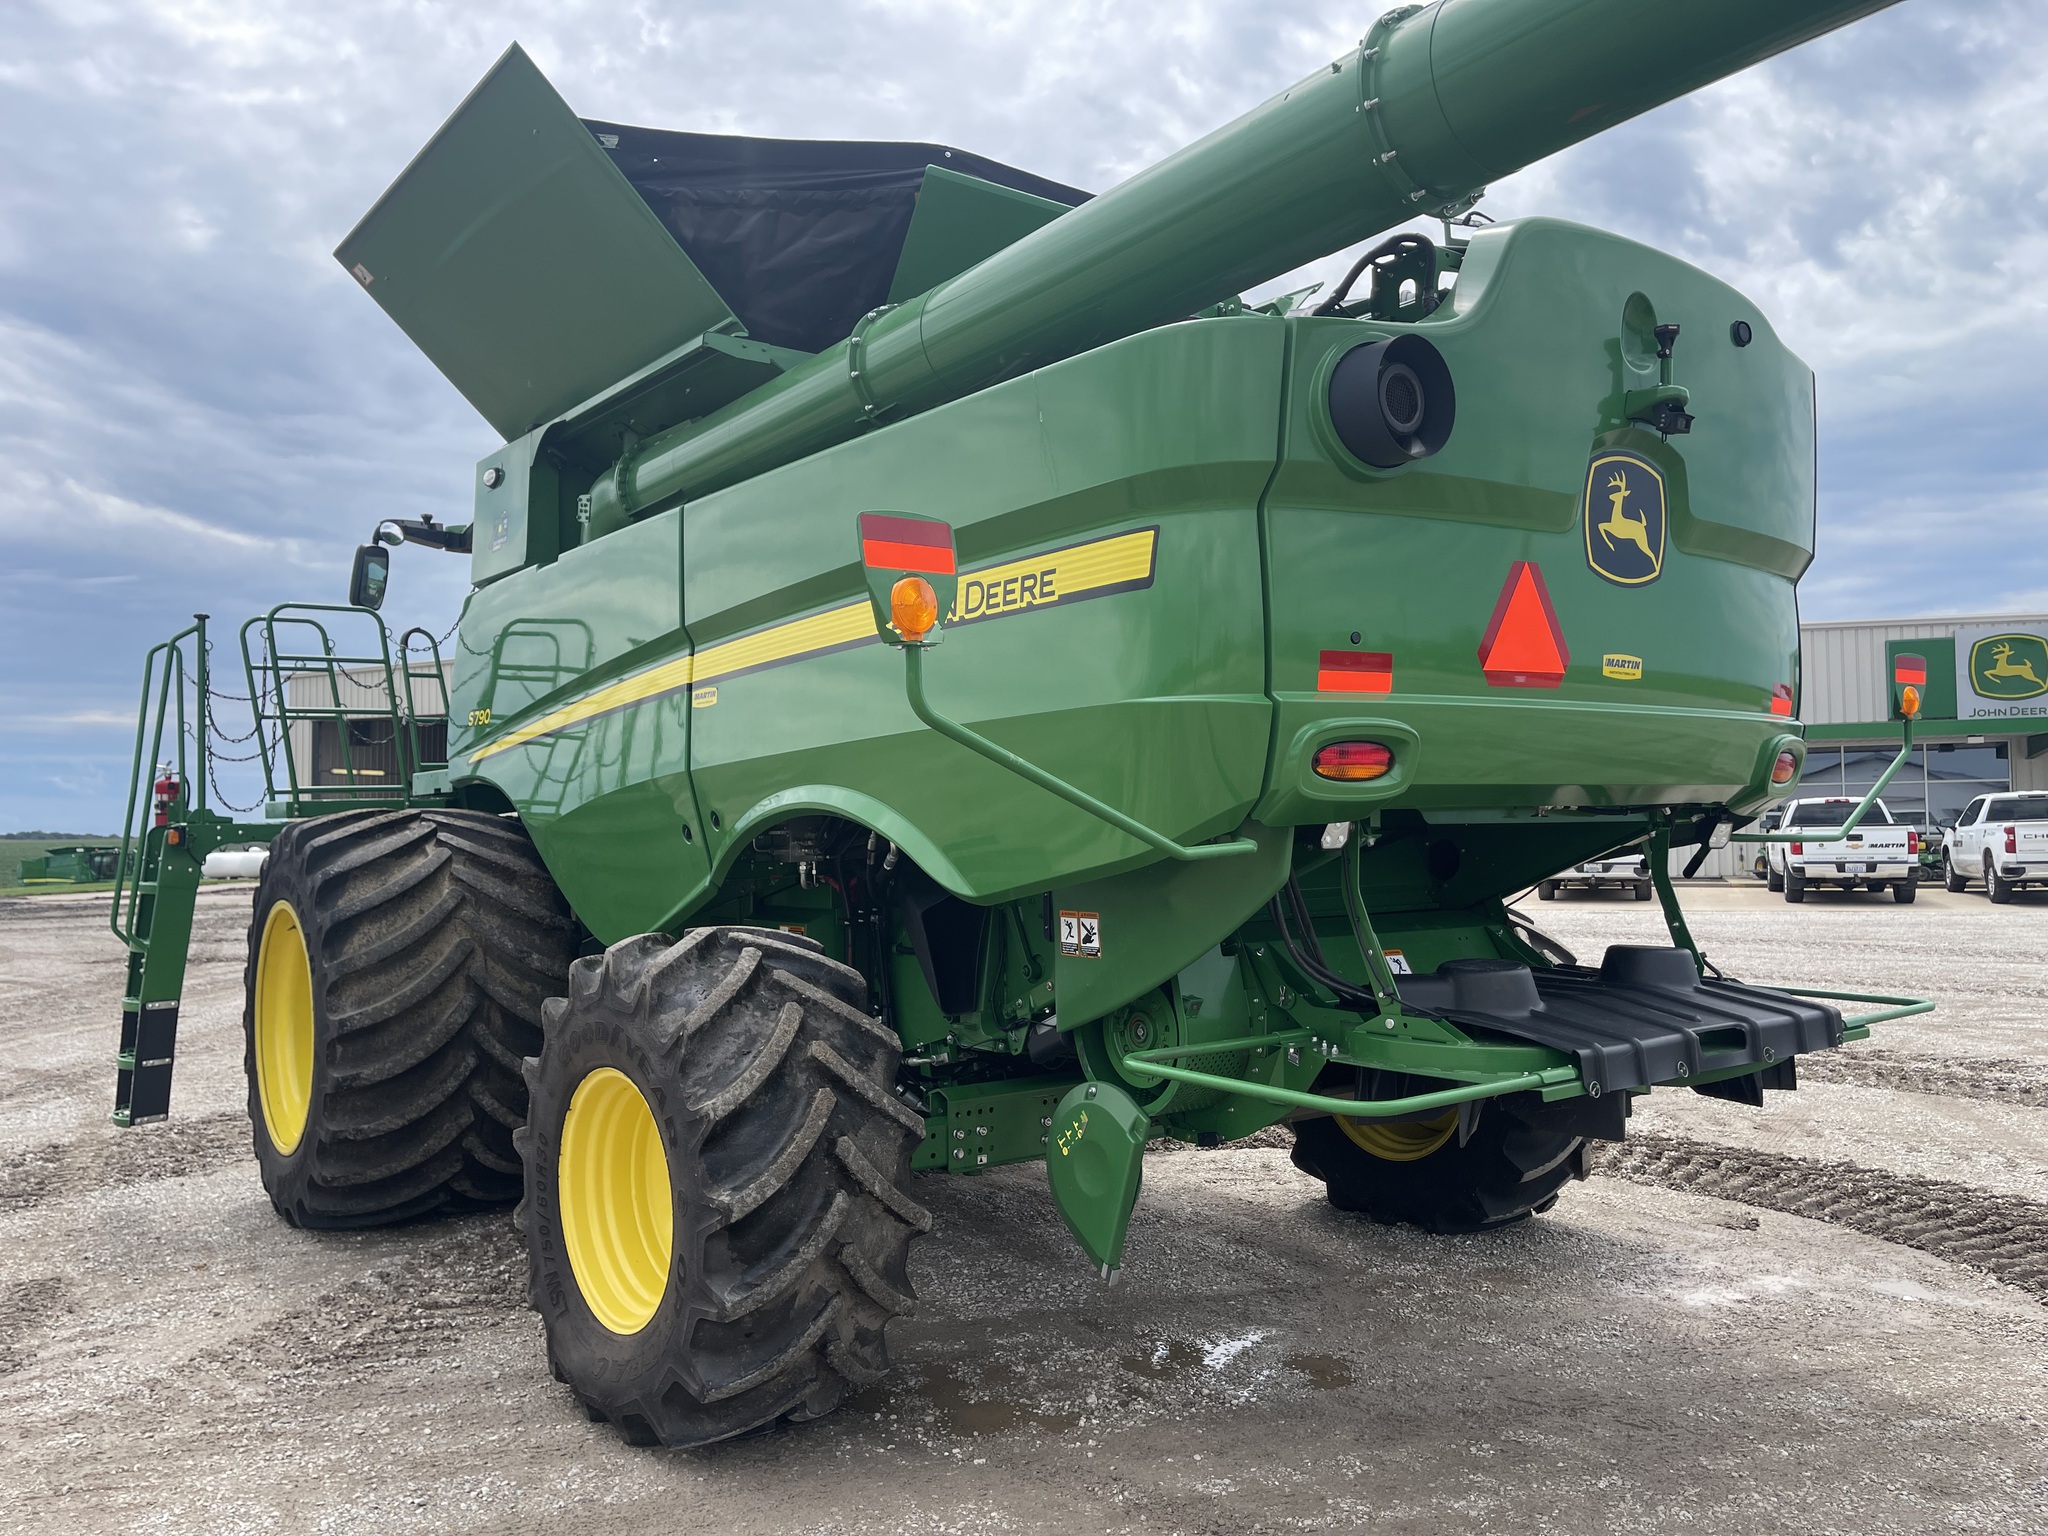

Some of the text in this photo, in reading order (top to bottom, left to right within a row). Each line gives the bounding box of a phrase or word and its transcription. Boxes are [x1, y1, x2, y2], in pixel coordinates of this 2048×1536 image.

[965, 568, 1057, 615] DEERE
[1605, 658, 1641, 670] MARTIN
[468, 708, 490, 727] S790
[1969, 706, 2048, 718] JOHN DEER
